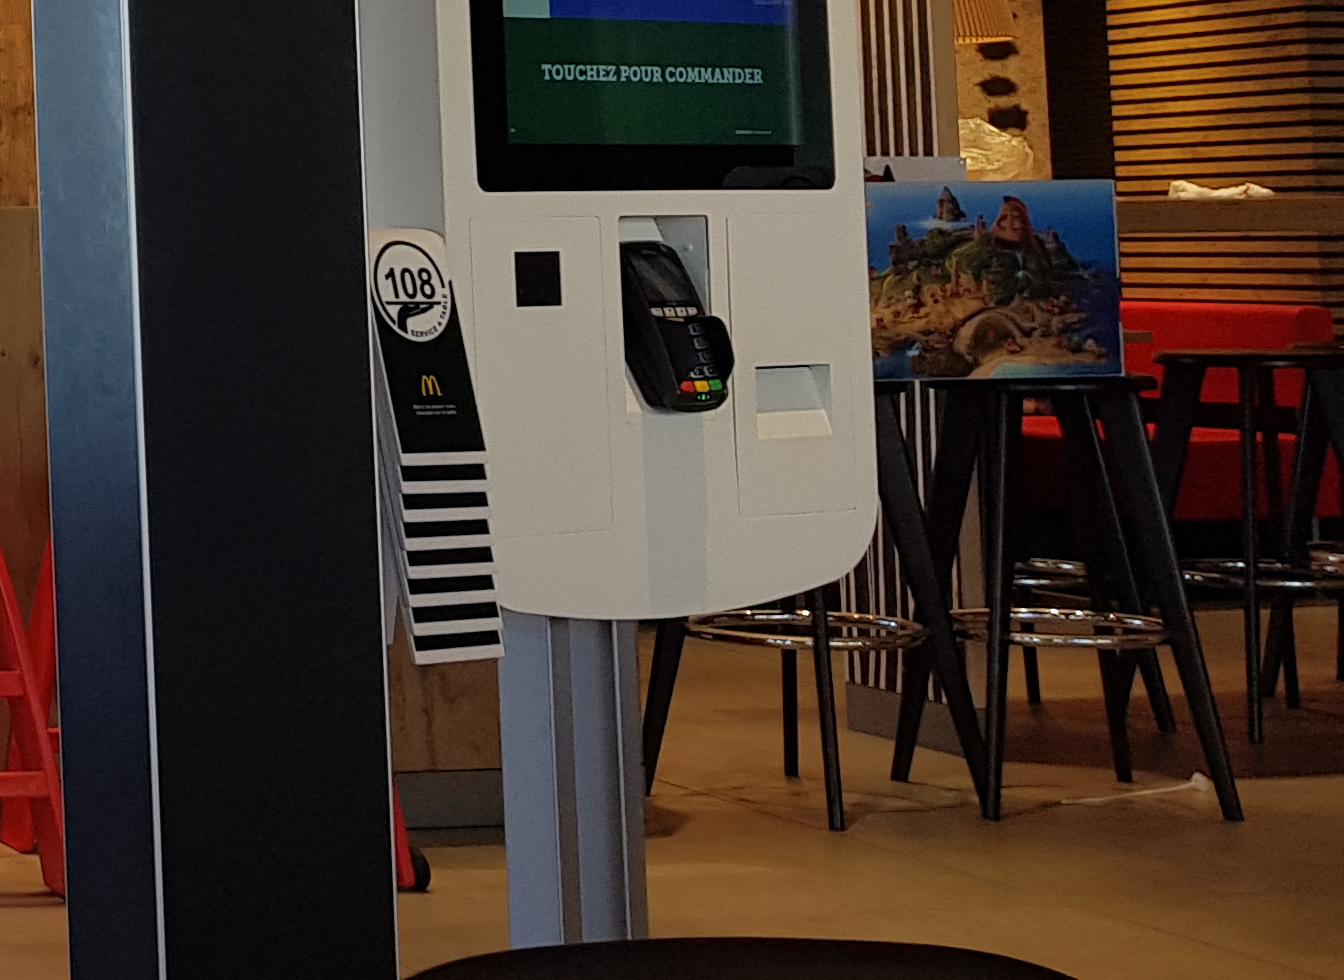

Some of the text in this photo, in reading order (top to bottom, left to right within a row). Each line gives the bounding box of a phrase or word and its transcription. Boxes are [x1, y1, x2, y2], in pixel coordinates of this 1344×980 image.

[541, 63, 764, 85] TOUCHEZ POUR COMMANDER
[384, 267, 436, 300] 108
